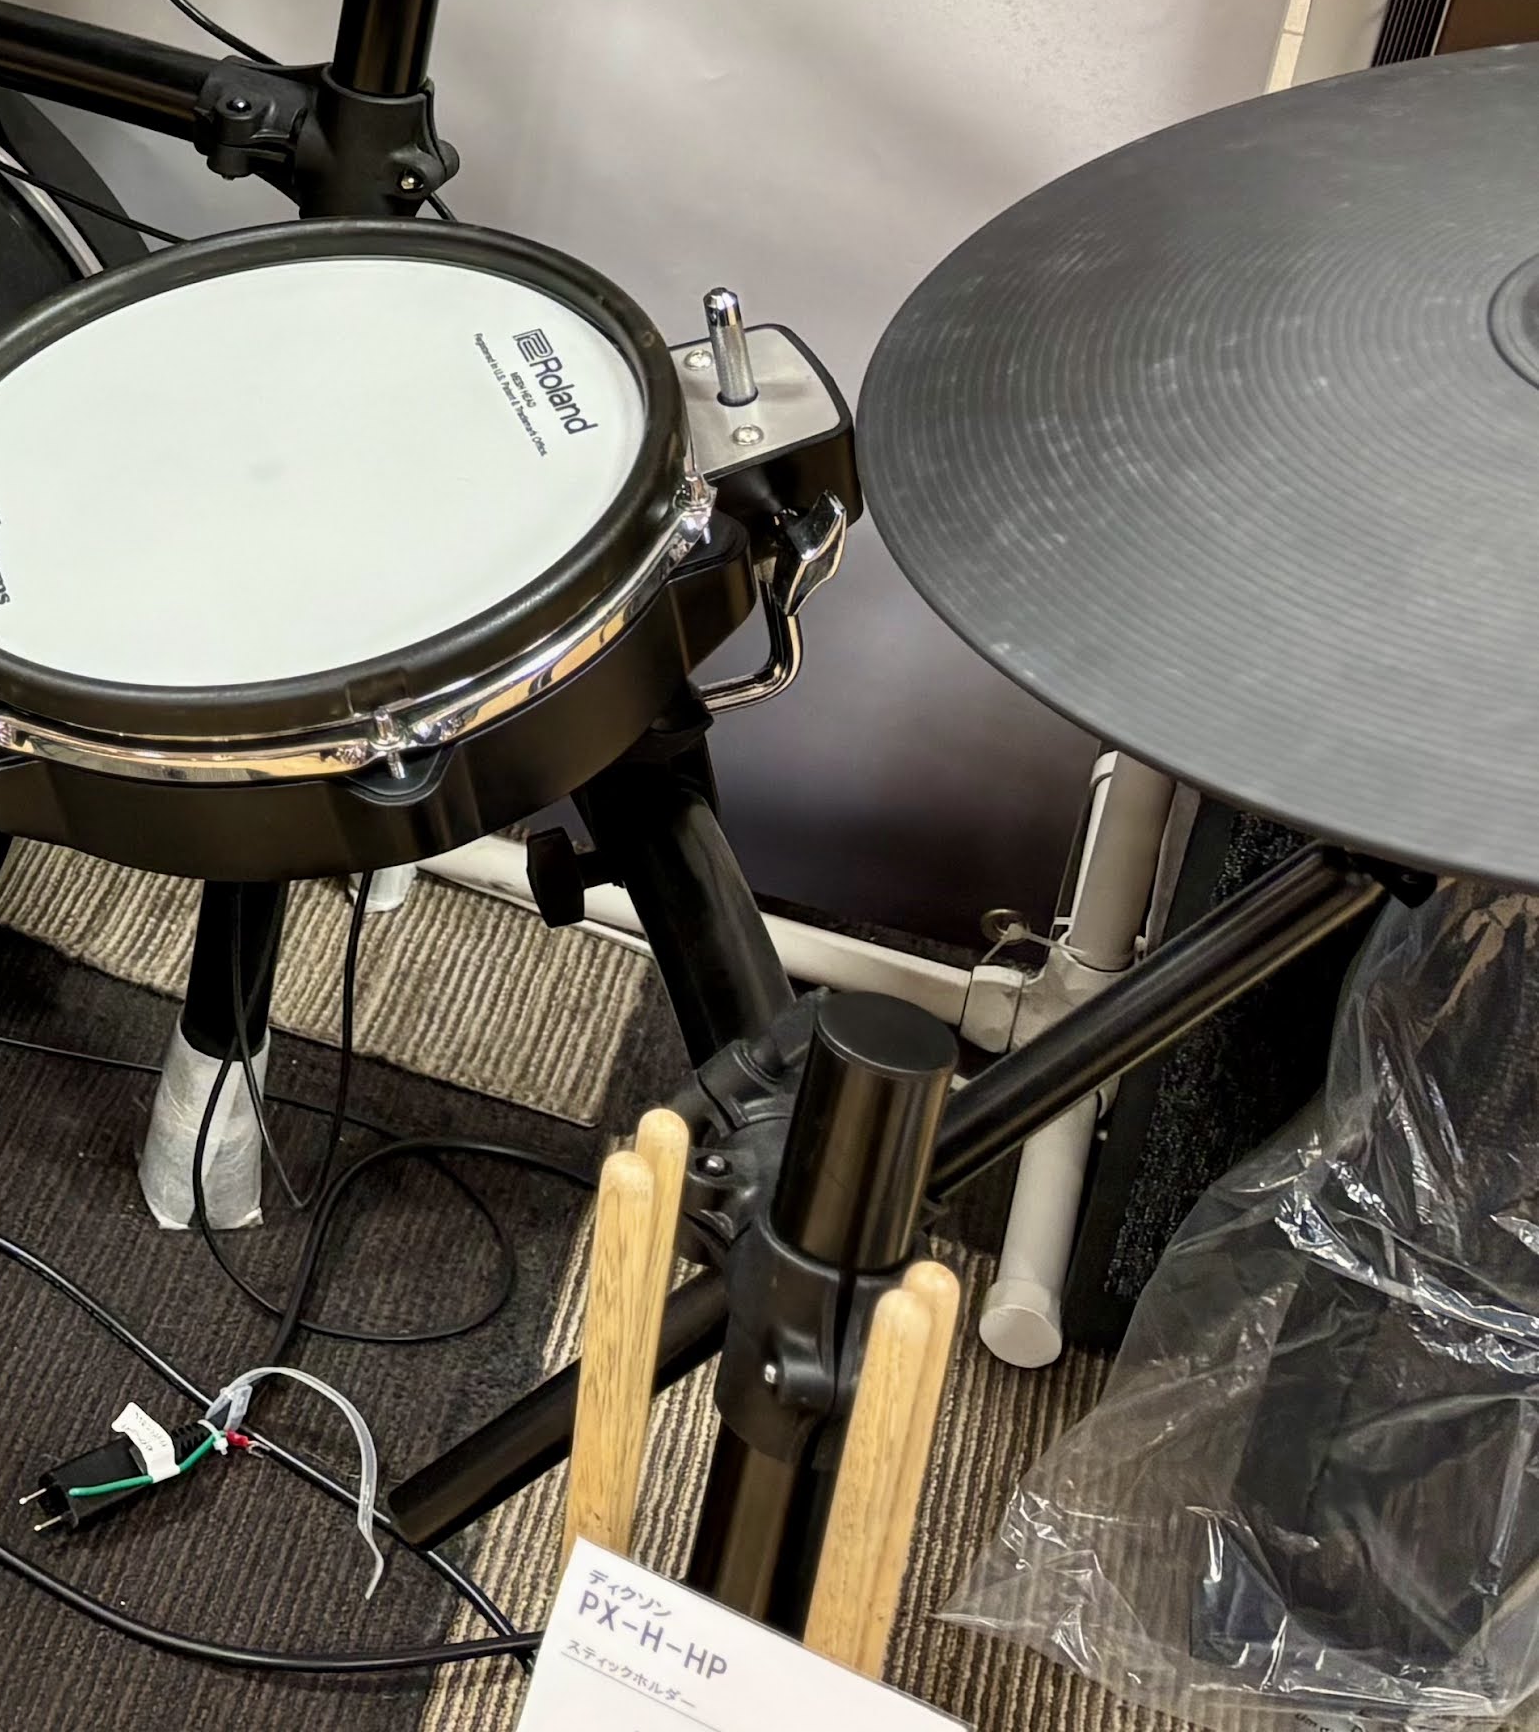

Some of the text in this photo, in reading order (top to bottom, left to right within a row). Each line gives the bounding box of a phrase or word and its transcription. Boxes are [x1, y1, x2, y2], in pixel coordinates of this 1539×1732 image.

[529, 356, 599, 435] Roland
[589, 1568, 672, 1618] ディクソン
[577, 1588, 728, 1680] PX-H-HP
[566, 1638, 699, 1710] スティックホルダー
